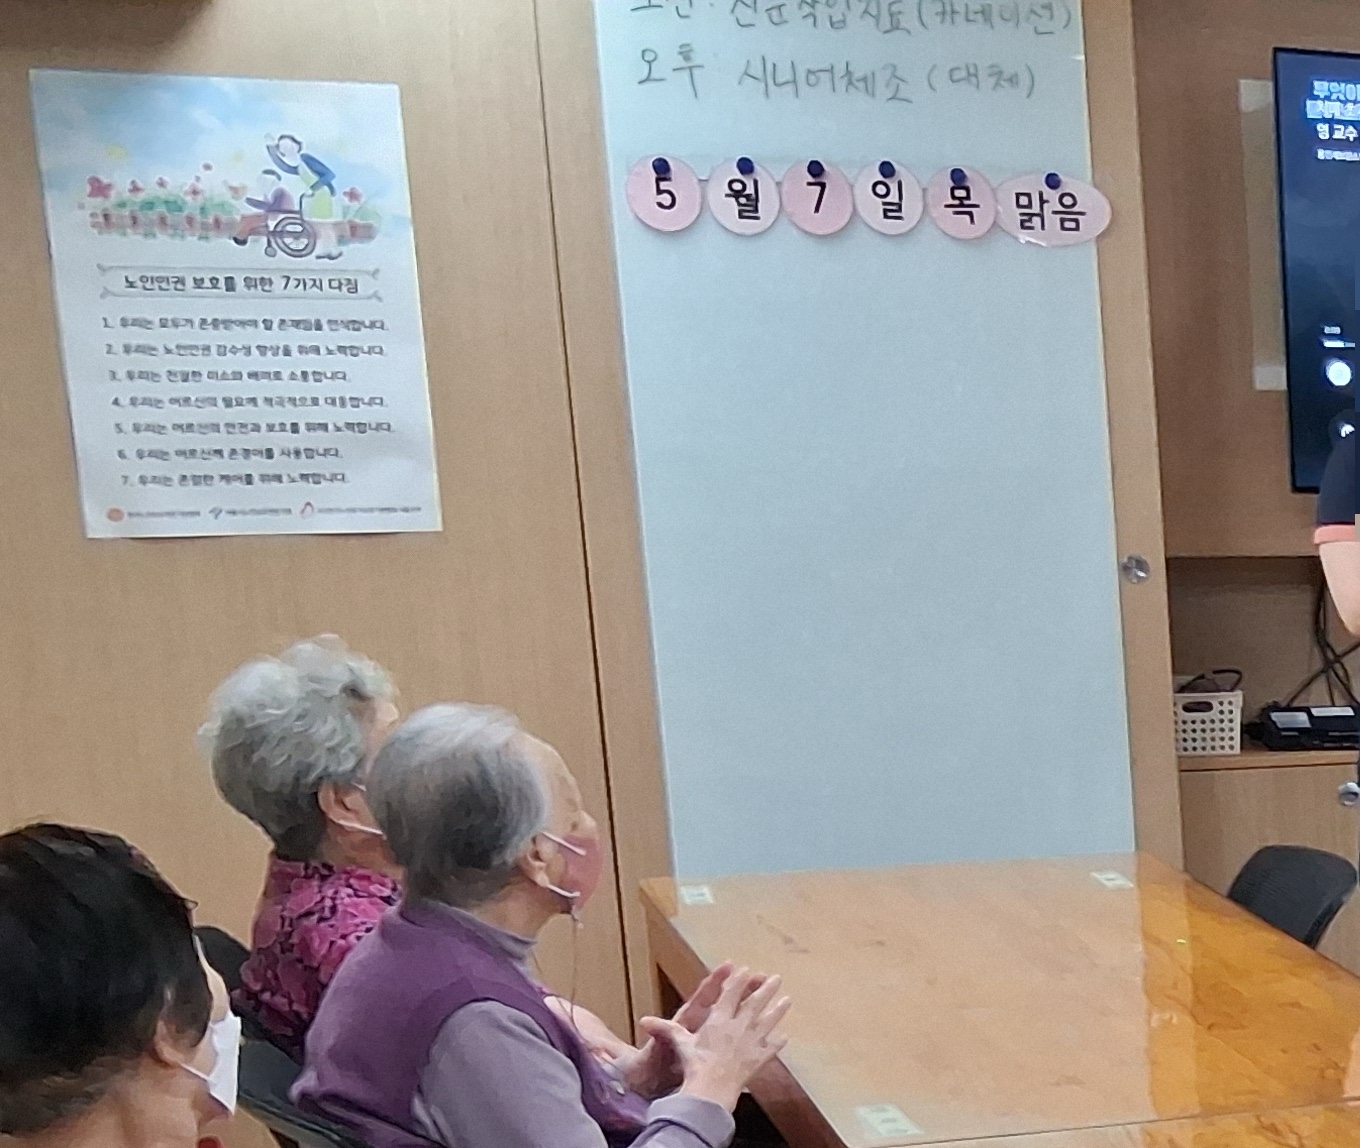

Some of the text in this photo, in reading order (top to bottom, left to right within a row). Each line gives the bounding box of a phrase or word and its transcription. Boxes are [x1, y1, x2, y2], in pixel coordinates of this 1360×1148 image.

[638, 43, 705, 99] 오후
[738, 54, 914, 104] 시니어체조
[1332, 124, 1358, 142] 교수
[654, 176, 1087, 233] 5 월 7 일 목 맑음
[124, 275, 186, 292] 노인인권
[281, 275, 323, 292] 7가지
[328, 277, 359, 294] 다짐
